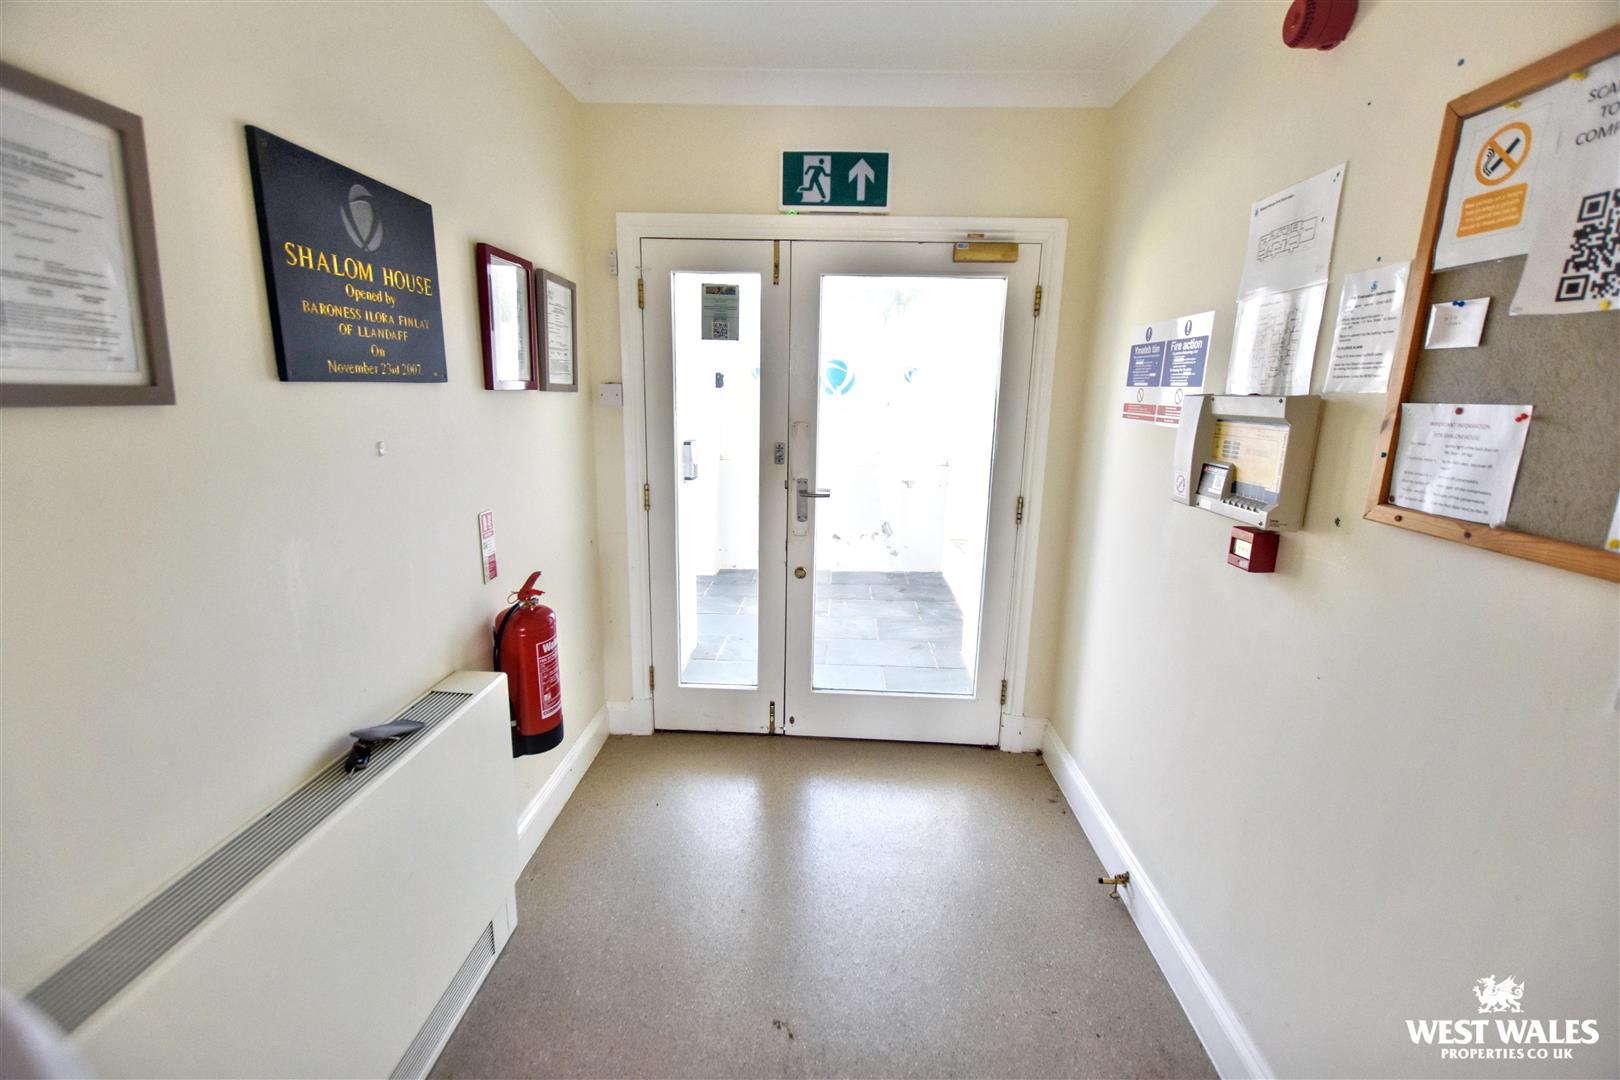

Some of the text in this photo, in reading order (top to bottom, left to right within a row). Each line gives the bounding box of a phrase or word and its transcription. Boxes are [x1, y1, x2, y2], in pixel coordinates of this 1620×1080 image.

[284, 241, 433, 297] SHALOM HOUSE
[345, 283, 396, 308] Opened by
[302, 300, 430, 329] BARONESS ILORA FINLAY
[338, 323, 409, 342] OF LLANDAFF
[370, 344, 386, 358] On
[1170, 338, 1203, 352] Fire action
[327, 360, 379, 375] November
